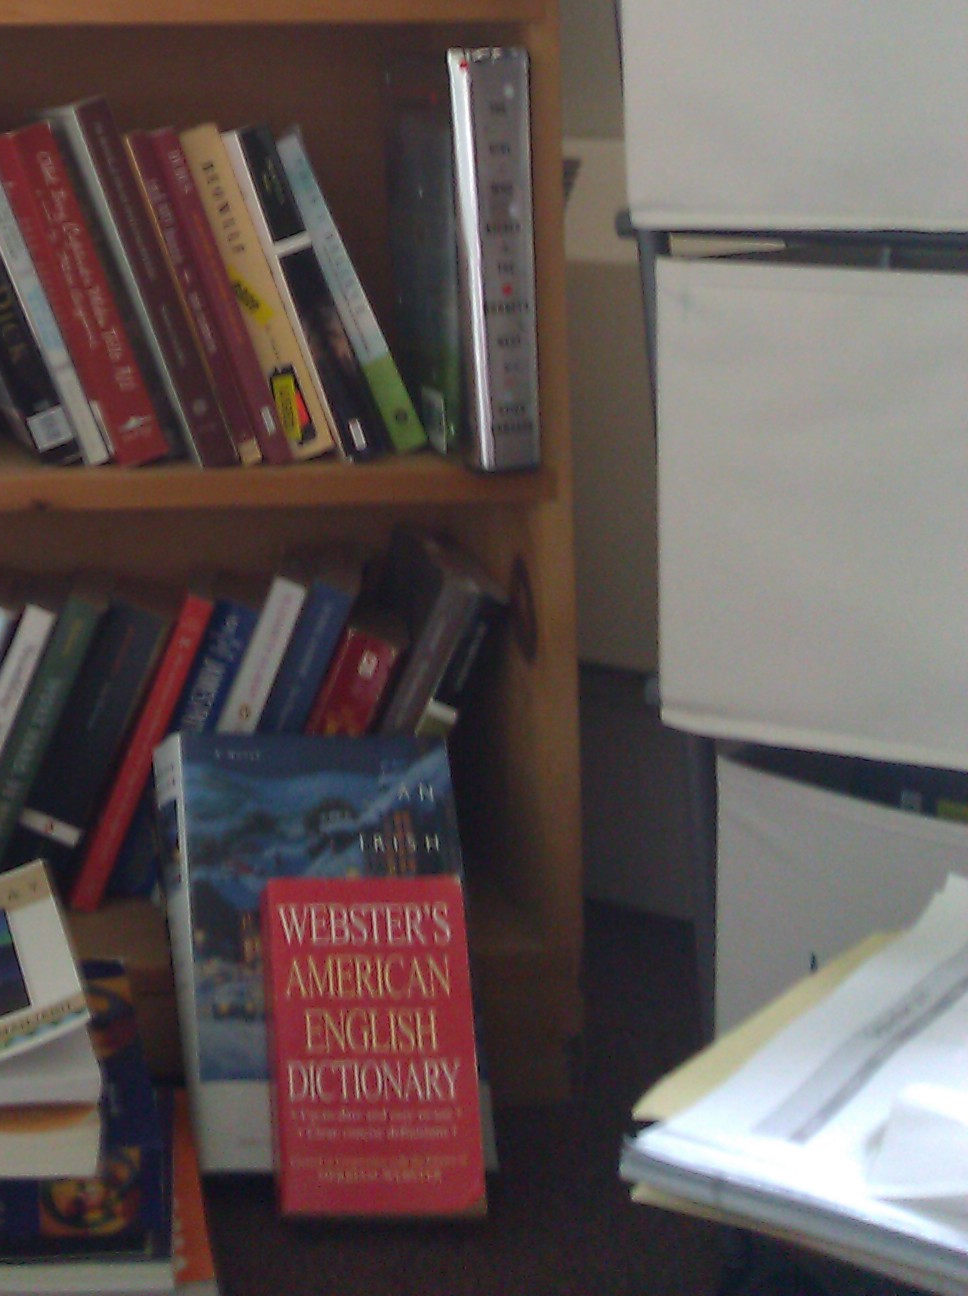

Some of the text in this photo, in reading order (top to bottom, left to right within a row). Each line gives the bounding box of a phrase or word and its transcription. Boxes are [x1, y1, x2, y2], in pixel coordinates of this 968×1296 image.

[398, 782, 434, 802] AN
[359, 833, 439, 853] IRISH
[278, 902, 452, 946] WEBSTER'S
[287, 954, 452, 998] AMERICAN
[305, 1008, 438, 1053] ENGLISH
[287, 1059, 460, 1102] DICTIONARY
